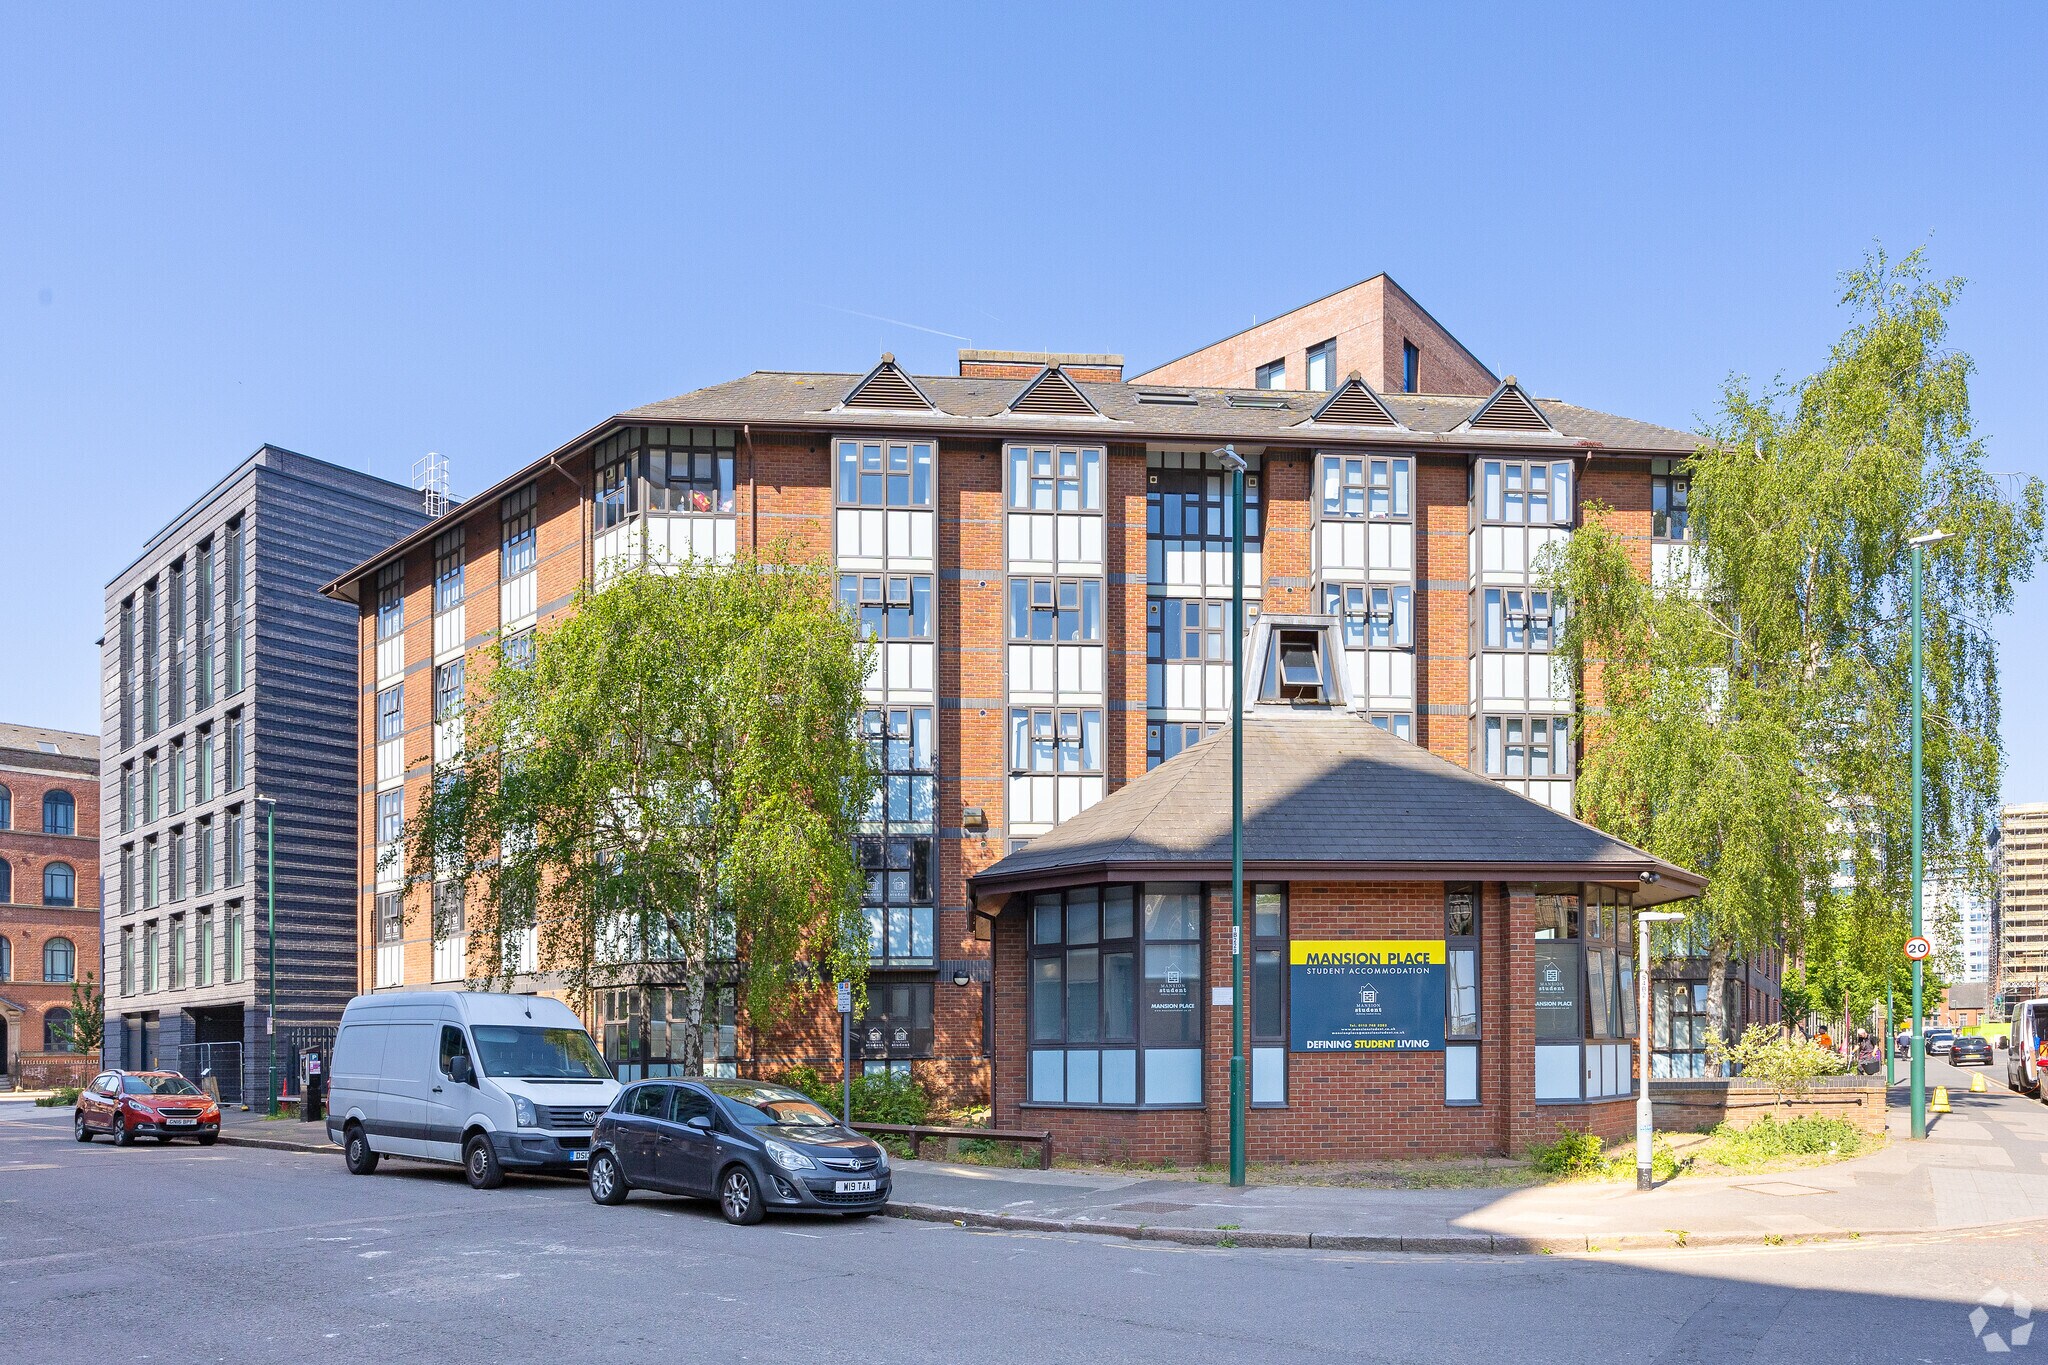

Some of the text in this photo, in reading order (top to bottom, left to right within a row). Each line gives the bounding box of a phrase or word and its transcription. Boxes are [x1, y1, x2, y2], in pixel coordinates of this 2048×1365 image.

[1908, 943, 1926, 954] 20
[1306, 952, 1430, 965] MANSION PLACE
[1306, 967, 1430, 975] STUDENT ACCOMMODATION
[1306, 1039, 1430, 1049] DEFINING STUDENT LIVING
[857, 1181, 871, 1191] TAA
